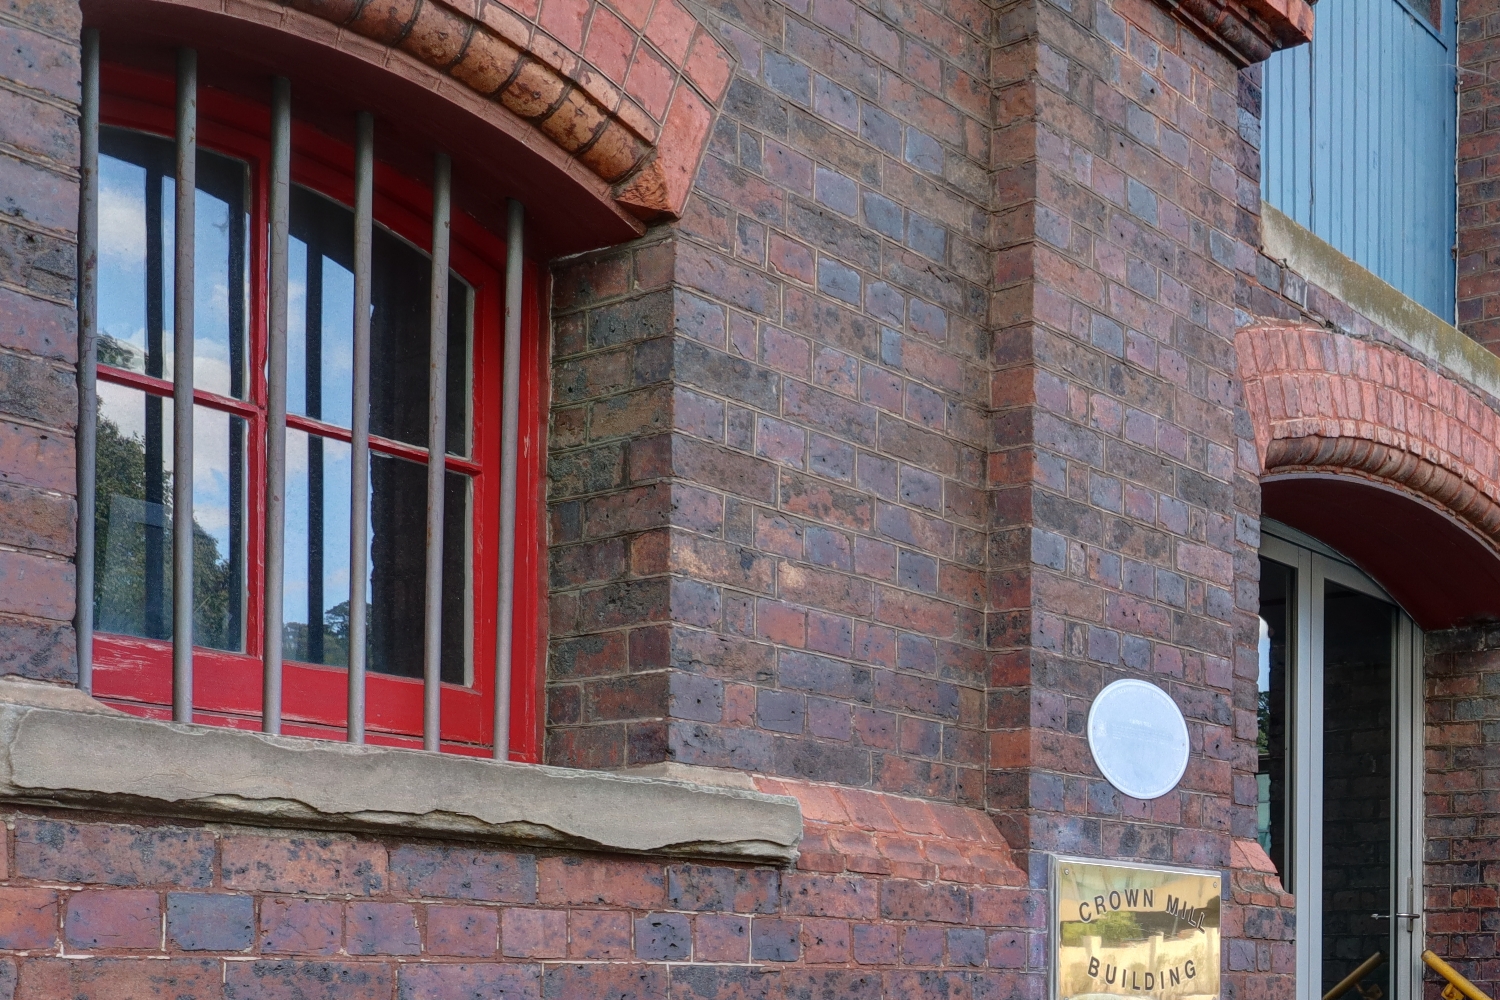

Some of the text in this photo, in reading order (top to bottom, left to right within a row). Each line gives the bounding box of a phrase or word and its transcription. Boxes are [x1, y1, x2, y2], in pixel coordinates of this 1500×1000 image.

[1078, 888, 1206, 934] CROWN MILL
[1088, 955, 1197, 991] BUILDING
